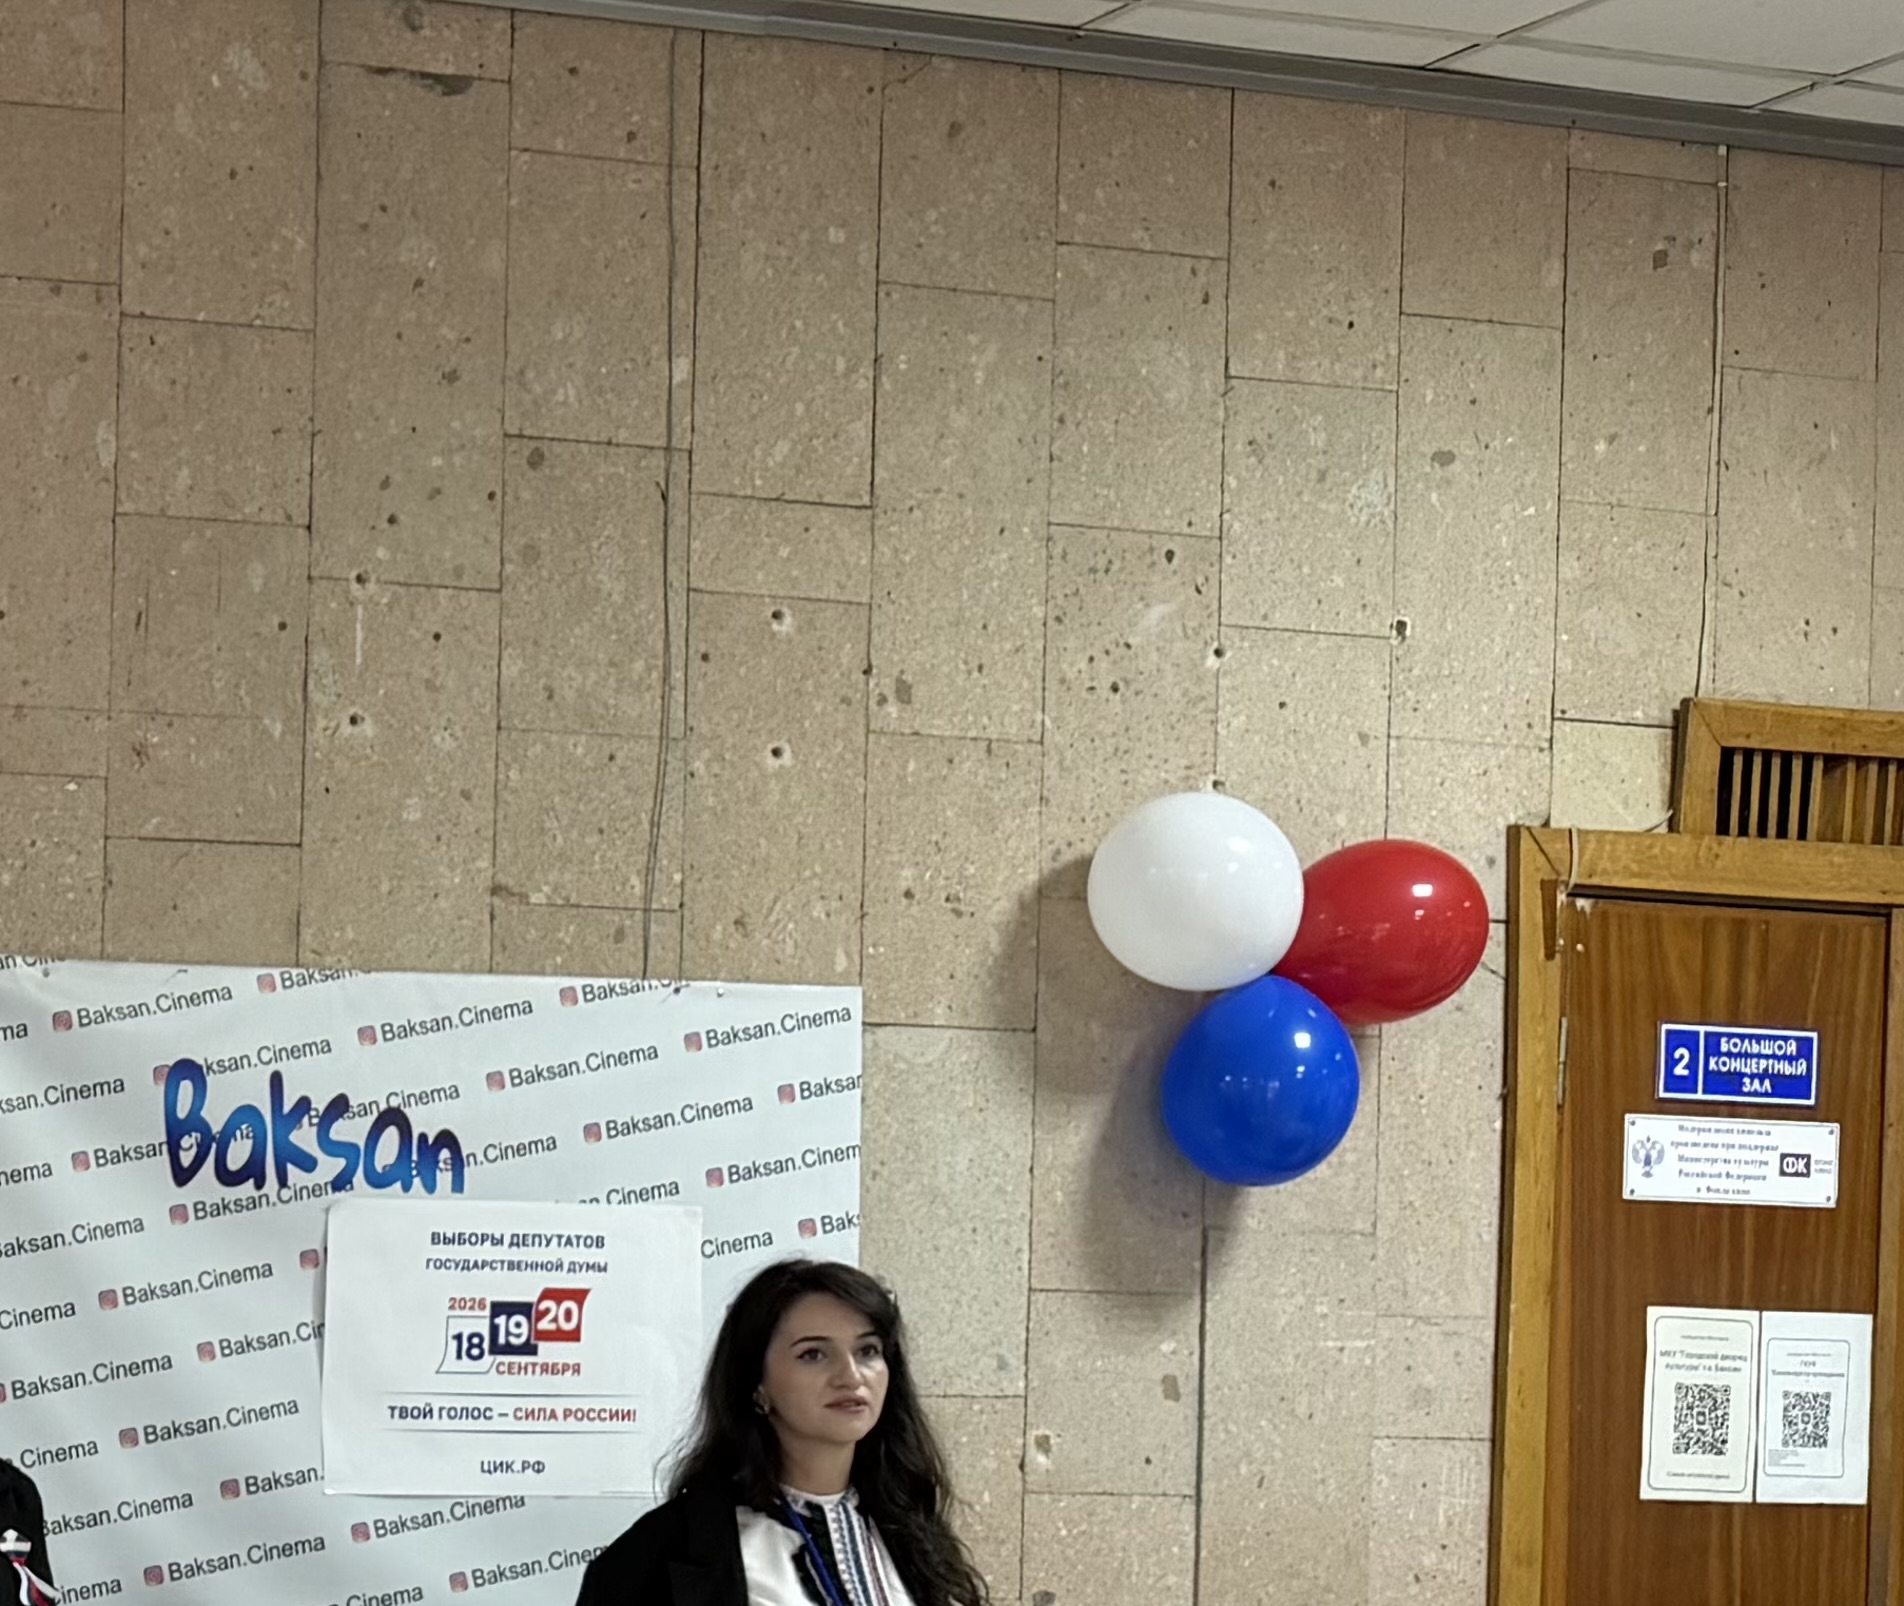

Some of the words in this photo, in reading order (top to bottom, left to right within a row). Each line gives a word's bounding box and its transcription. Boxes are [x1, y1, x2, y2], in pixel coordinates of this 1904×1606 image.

[77, 985, 233, 1028] Baksan.Cinema
[380, 998, 534, 1043] Baksan.Cinema
[705, 1005, 852, 1048] Baksan.Cinema
[204, 1036, 333, 1078] ksan.Cinema
[1672, 1047, 1690, 1076] 2
[1720, 1037, 1797, 1056] БОЛЬШОЙ
[508, 1044, 659, 1088] Baksan.Cinema
[1708, 1056, 1807, 1076] КОНЦЕРТНЫЙ
[1742, 1078, 1772, 1093] ЗАЛ
[164, 1058, 465, 1194] Baksan
[605, 1095, 754, 1139] Baksan.Cinema
[727, 1143, 861, 1185] Baksan.Cinem
[1782, 1156, 1808, 1175] ФК
[430, 1231, 505, 1249] ВЫБОРЫ
[508, 1233, 606, 1251] ДЕПУТАТОВ
[425, 1256, 564, 1273] ГОСУДАРСТВЕННОЙ
[566, 1260, 608, 1275] ДУМЫ
[122, 1261, 274, 1306] Baksan.Cinema
[448, 1297, 487, 1312] 2026
[536, 1300, 579, 1331] 20
[218, 1320, 325, 1359] Baksan.Ci
[451, 1331, 486, 1361] 18
[494, 1314, 529, 1346] 19
[11, 1352, 174, 1400] Baksan.Cinema
[495, 1361, 582, 1377] СЕНТЯБРЯ
[143, 1399, 300, 1444] Baksan.Cinema
[388, 1403, 434, 1421] ТВОЙ
[438, 1405, 494, 1421] ГОЛОС
[513, 1407, 558, 1422] СИЛА
[563, 1407, 637, 1423] РОССИИ!
[244, 1465, 325, 1496] Baksan.
[480, 1459, 546, 1476] ЦИК.РФ
[373, 1494, 526, 1540] Baksan.Cinema
[168, 1535, 326, 1582] Baksan.Cinema
